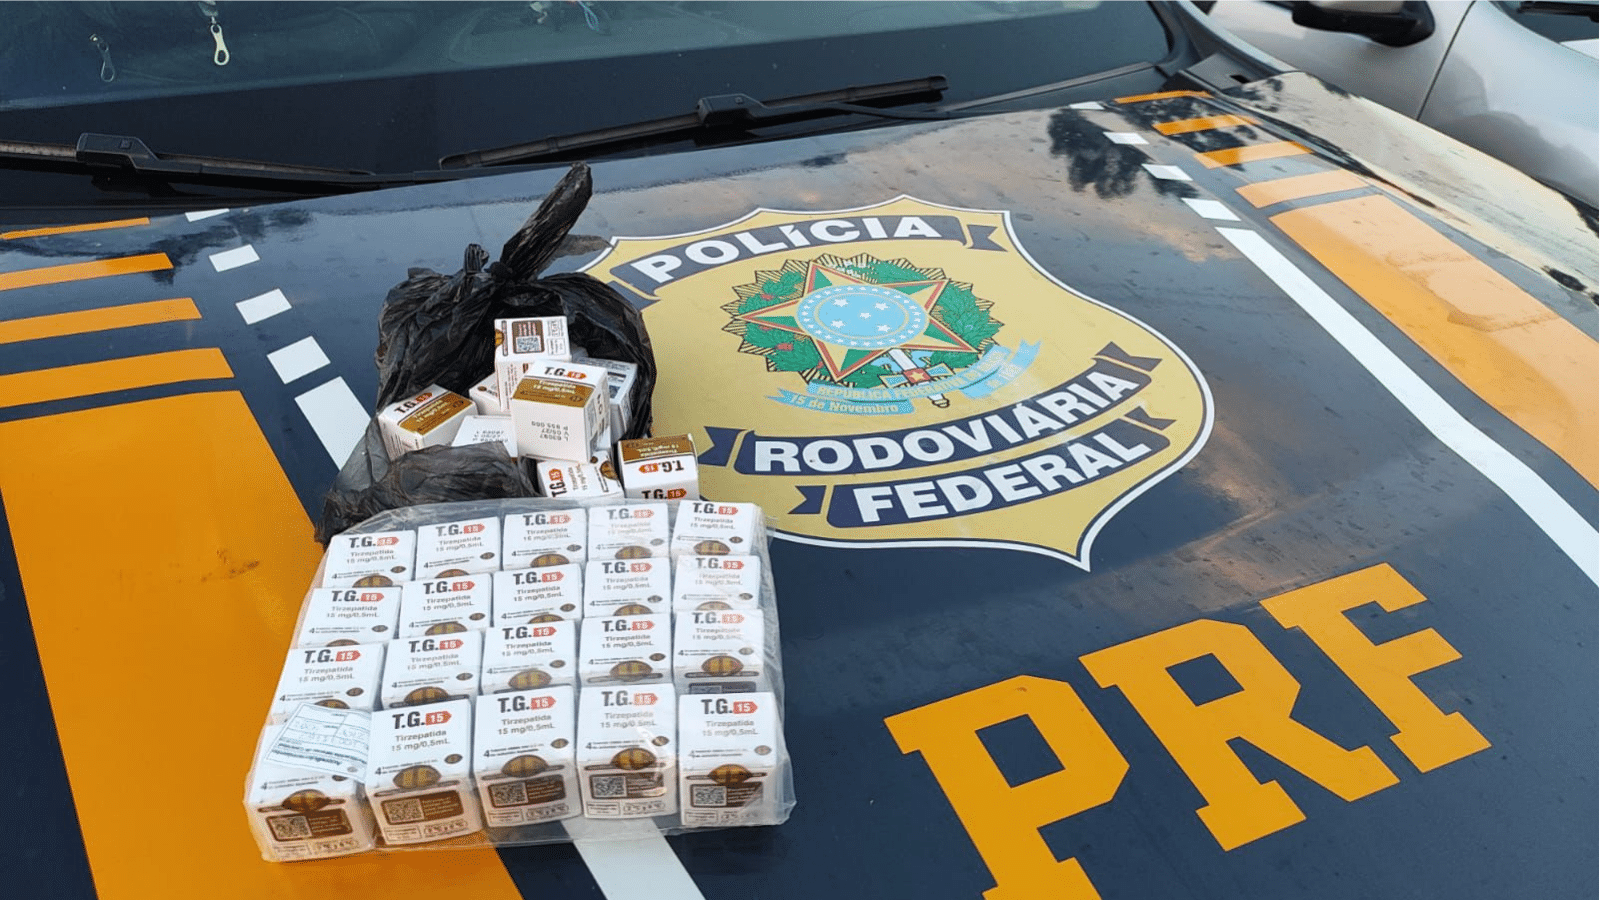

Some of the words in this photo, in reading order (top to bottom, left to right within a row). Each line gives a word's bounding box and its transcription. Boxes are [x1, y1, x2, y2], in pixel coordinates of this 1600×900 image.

[630, 216, 942, 284] POLÍCIA
[829, 401, 899, 413] Novembro
[754, 370, 1140, 473] RODOVIÁRIA
[852, 431, 1152, 523] FEDERAL
[606, 508, 633, 520] T.G.
[692, 502, 717, 515] T.G.
[522, 513, 550, 526] T.G.
[435, 523, 463, 537] T.G.
[349, 536, 376, 548] T.G.
[602, 561, 629, 574] T.G.
[695, 557, 722, 570] T.G.
[513, 571, 542, 586] T.G.
[422, 581, 452, 595] T.G.
[331, 590, 360, 603] T.G.
[691, 612, 721, 624] T.G.
[502, 626, 532, 640] T.G.
[601, 619, 631, 633] T.G.
[408, 639, 438, 653] T.G.
[304, 649, 334, 664] T.G.
[304, 665, 354, 675] Tirzepatida
[497, 695, 530, 714] T.G.
[534, 697, 549, 708] 15
[601, 690, 632, 707] T.G.
[700, 698, 732, 715] T.G.
[736, 702, 751, 712] 15
[392, 711, 426, 730] T.G.
[430, 712, 445, 724] 15
[501, 714, 552, 726] Tirzepatida
[604, 711, 654, 721] Tirzepatida
[705, 720, 754, 728] Tirzepatida
[883, 562, 1493, 900] PRF
[395, 728, 447, 742] Tirzepatida
